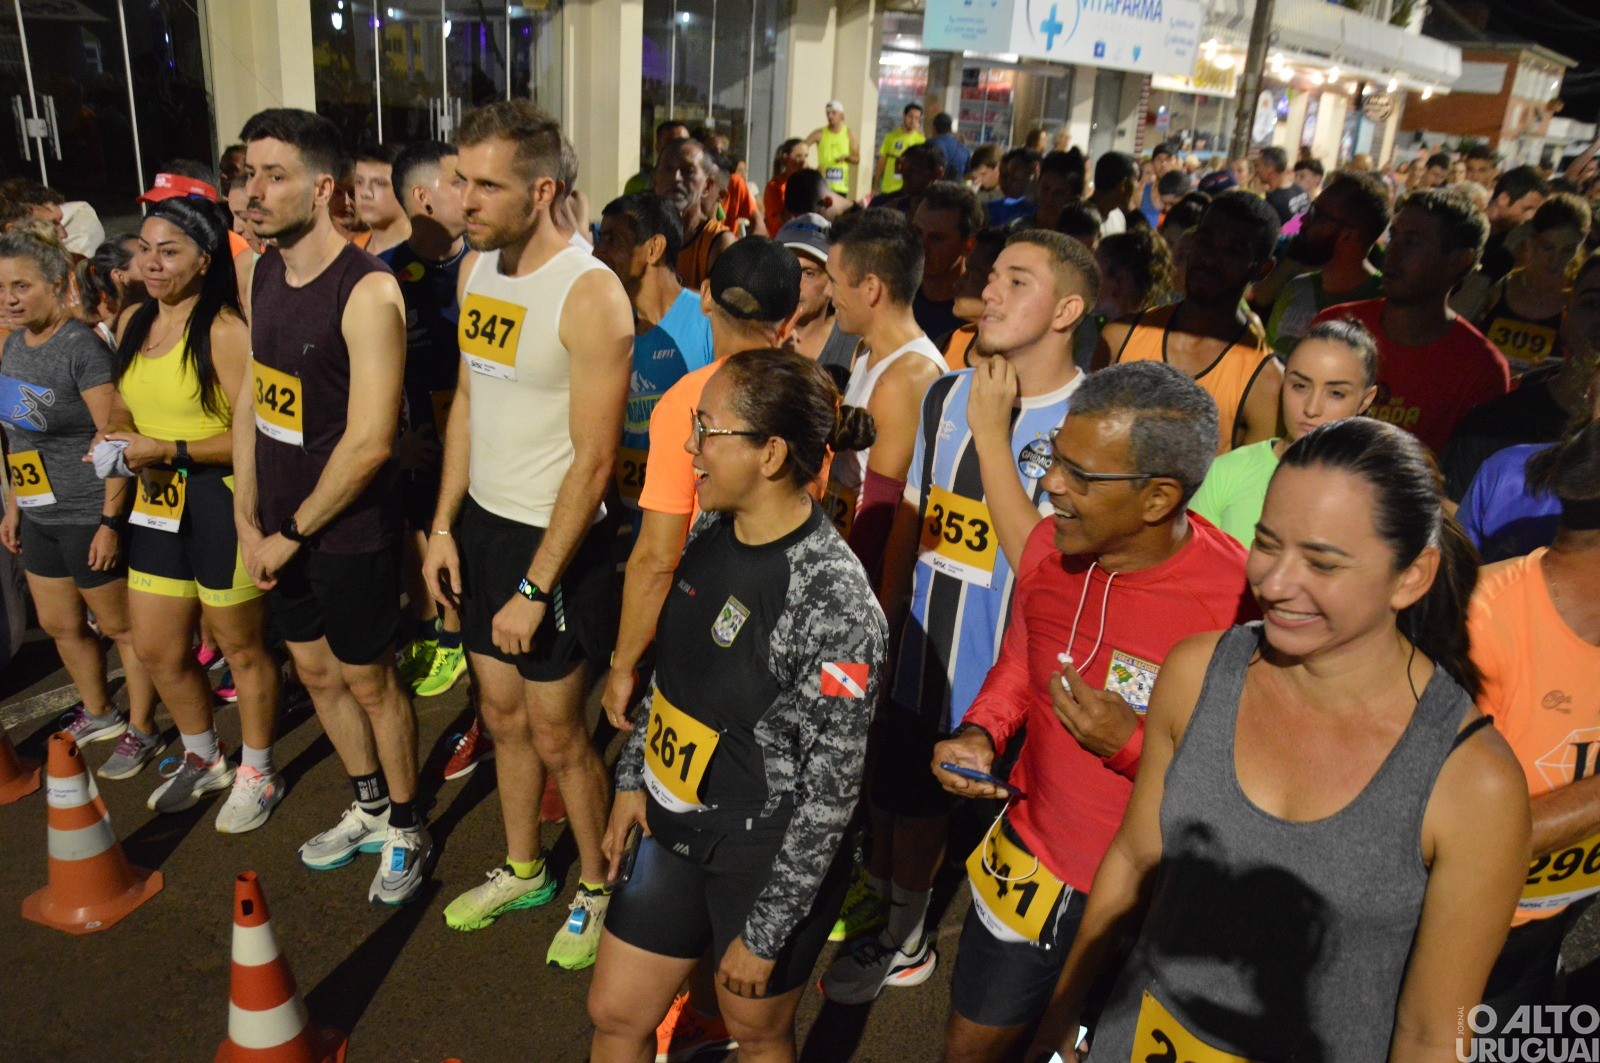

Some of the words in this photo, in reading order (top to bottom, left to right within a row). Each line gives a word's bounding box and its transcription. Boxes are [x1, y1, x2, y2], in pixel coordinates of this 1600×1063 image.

[465, 309, 515, 348] 347
[1494, 327, 1547, 353] 309
[652, 349, 676, 360] LEFIT
[256, 377, 295, 417] 342
[929, 504, 990, 552] 353
[650, 713, 697, 783] 261
